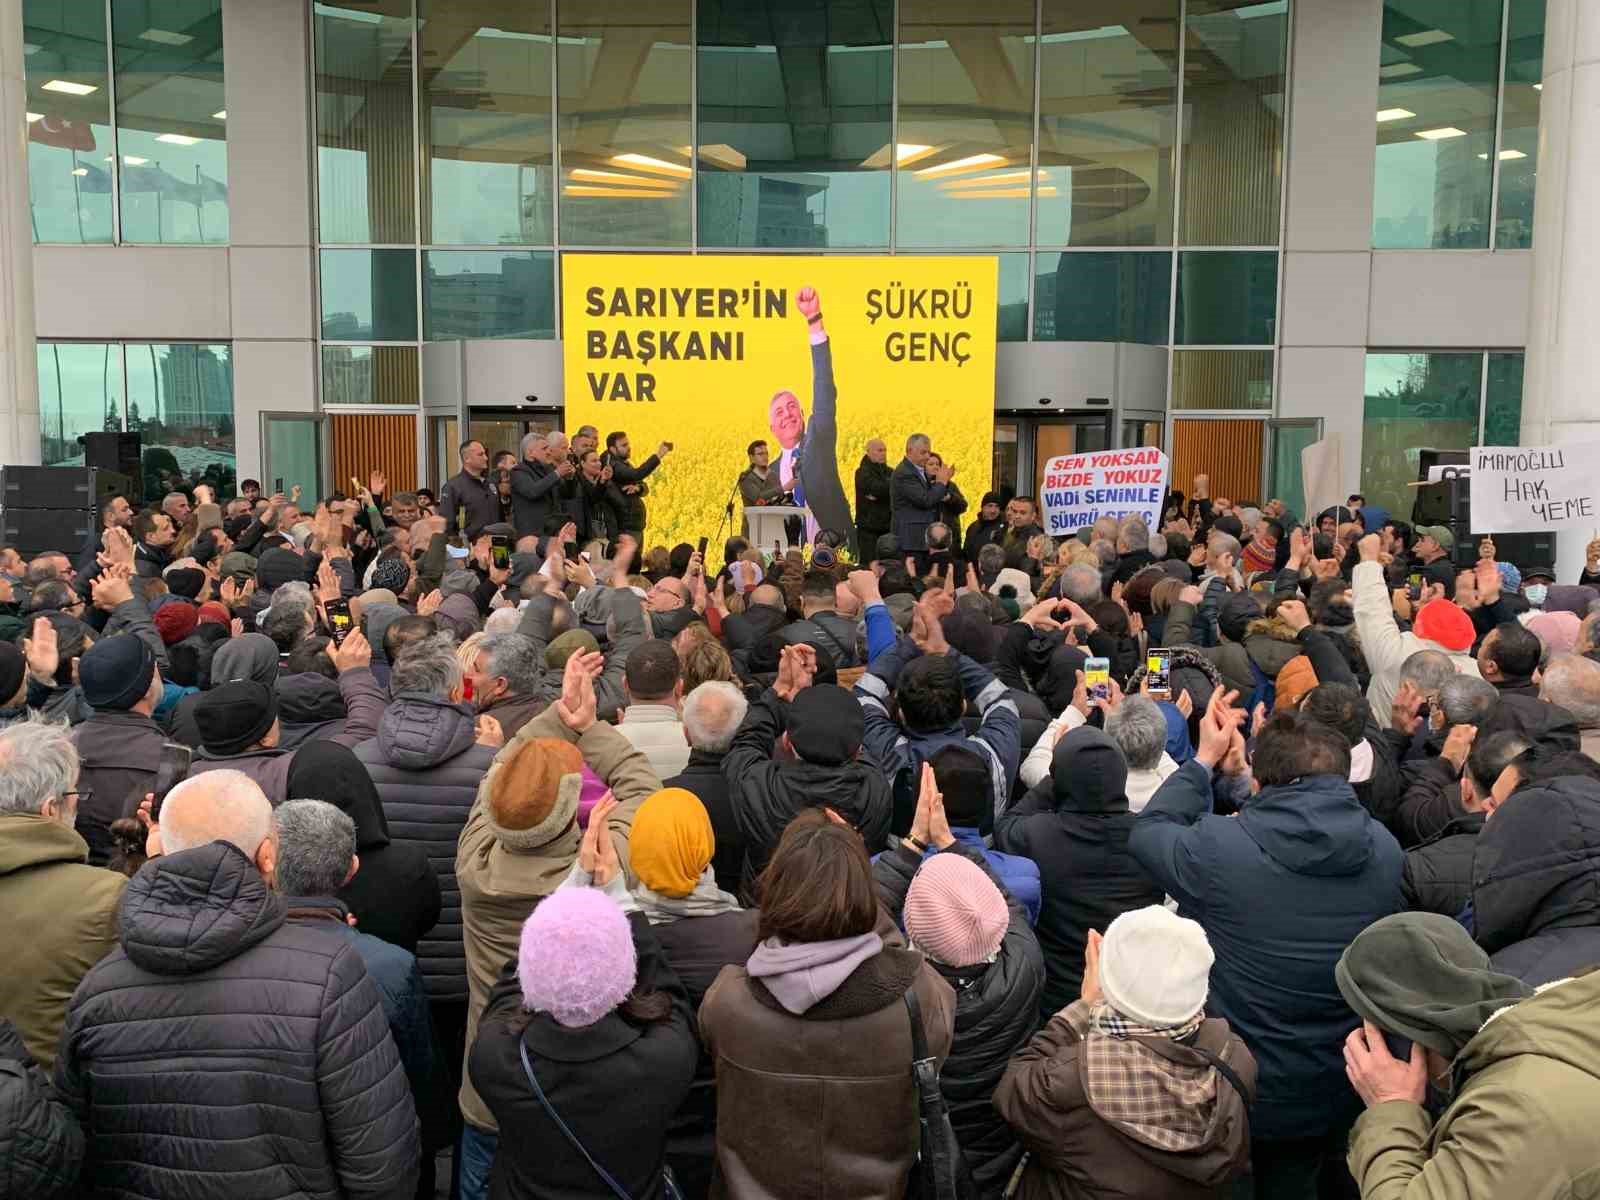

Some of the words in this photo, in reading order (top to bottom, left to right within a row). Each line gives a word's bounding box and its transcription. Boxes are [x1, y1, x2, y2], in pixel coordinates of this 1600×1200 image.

[866, 281, 972, 325] ŞÜKRÜ
[588, 330, 744, 366] BAŞKANI
[886, 331, 971, 368] GENÇ
[587, 372, 657, 402] VAR
[1053, 458, 1086, 471] SEN
[1091, 451, 1160, 468] YOKSAN
[1104, 469, 1163, 485] YOKUZ
[1504, 477, 1550, 502] HAK
[1531, 497, 1593, 522] YEME
